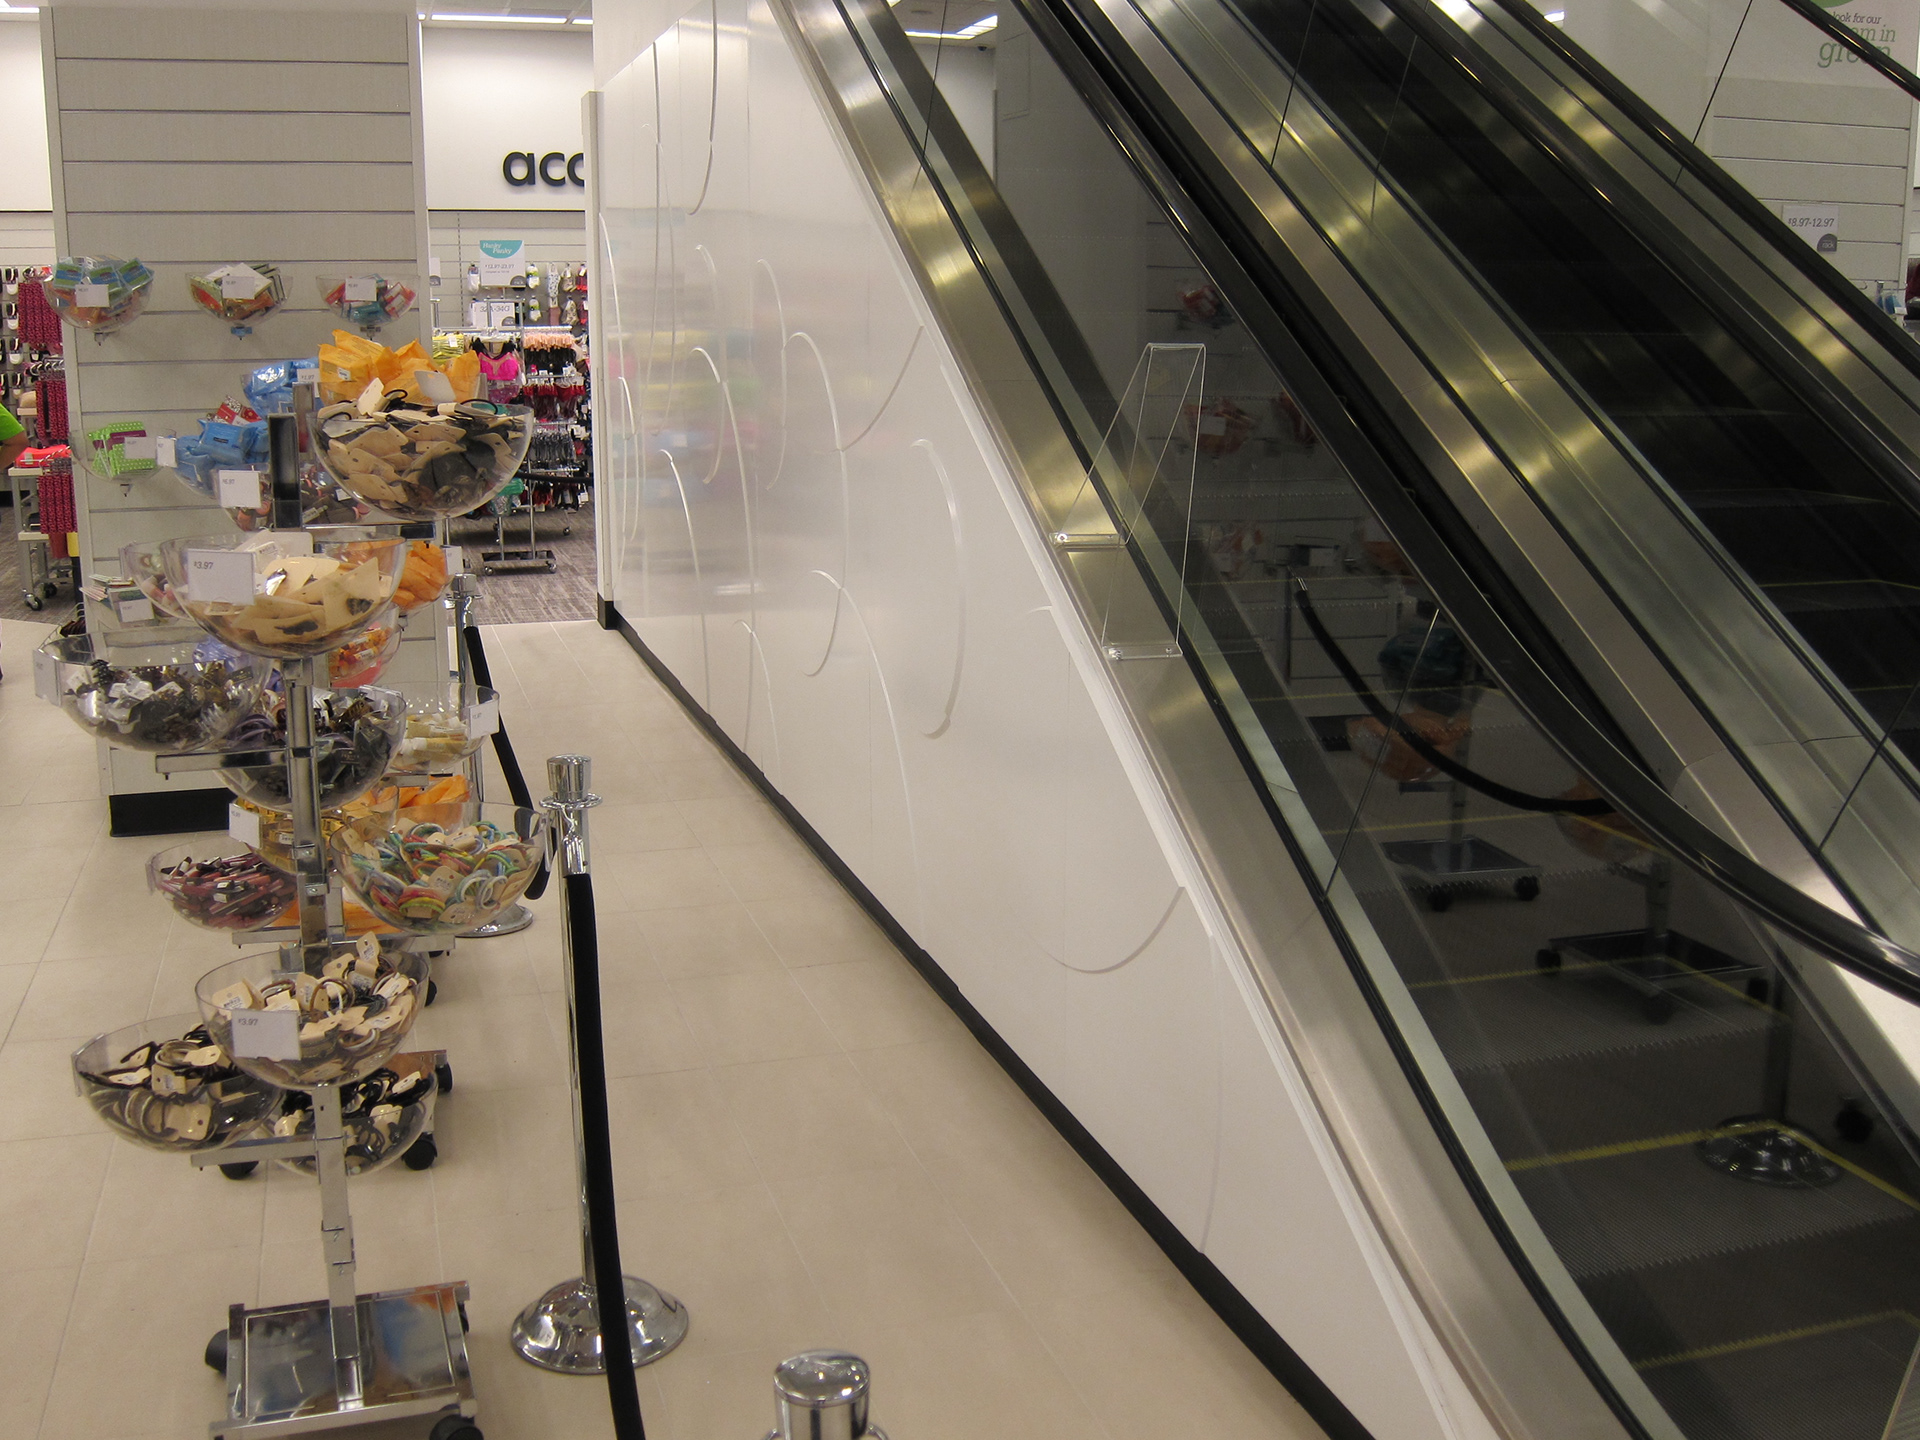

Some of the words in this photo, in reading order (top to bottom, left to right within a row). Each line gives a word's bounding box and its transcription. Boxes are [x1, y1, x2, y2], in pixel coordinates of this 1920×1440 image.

[1853, 13, 1866, 23] for
[1866, 16, 1882, 24] our
[1879, 24, 1896, 42] in
[1817, 42, 1891, 68] gren
[502, 151, 584, 187] acc
[1787, 217, 1835, 228] $8.97-12.97
[193, 560, 214, 570] $3.97
[237, 1017, 259, 1026] $3.97
